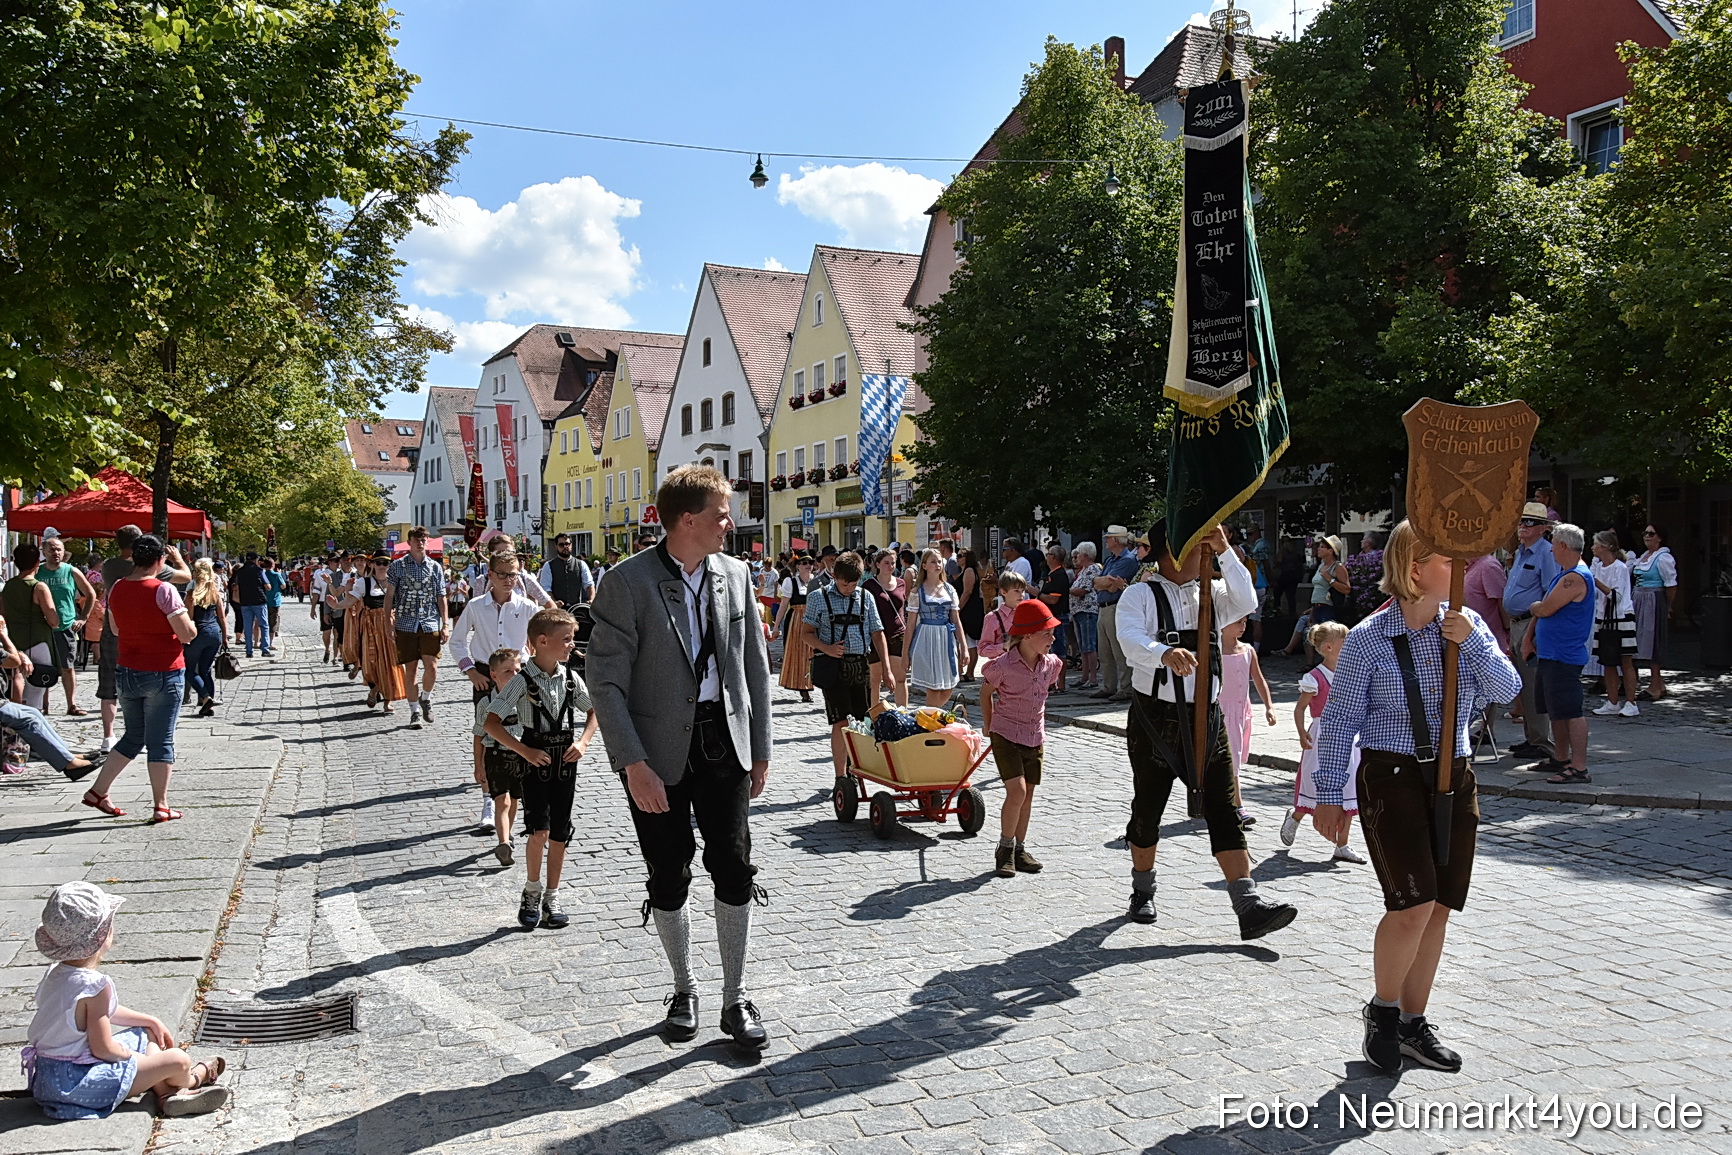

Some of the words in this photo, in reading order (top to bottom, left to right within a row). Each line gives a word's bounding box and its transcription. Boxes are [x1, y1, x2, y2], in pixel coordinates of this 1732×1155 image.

[1193, 94, 1234, 119] 2001
[1202, 191, 1225, 207] Den
[1190, 206, 1238, 227] Toten
[1207, 226, 1225, 237] zur
[1194, 240, 1236, 267] Ehr
[1192, 314, 1242, 332] Schützenverein
[1191, 349, 1245, 365] Berg
[1418, 404, 1531, 434] Schützenverein
[566, 465, 581, 478] HOTEL
[566, 521, 585, 530] Restaurant
[804, 509, 812, 525] P
[1445, 509, 1485, 534] Berg
